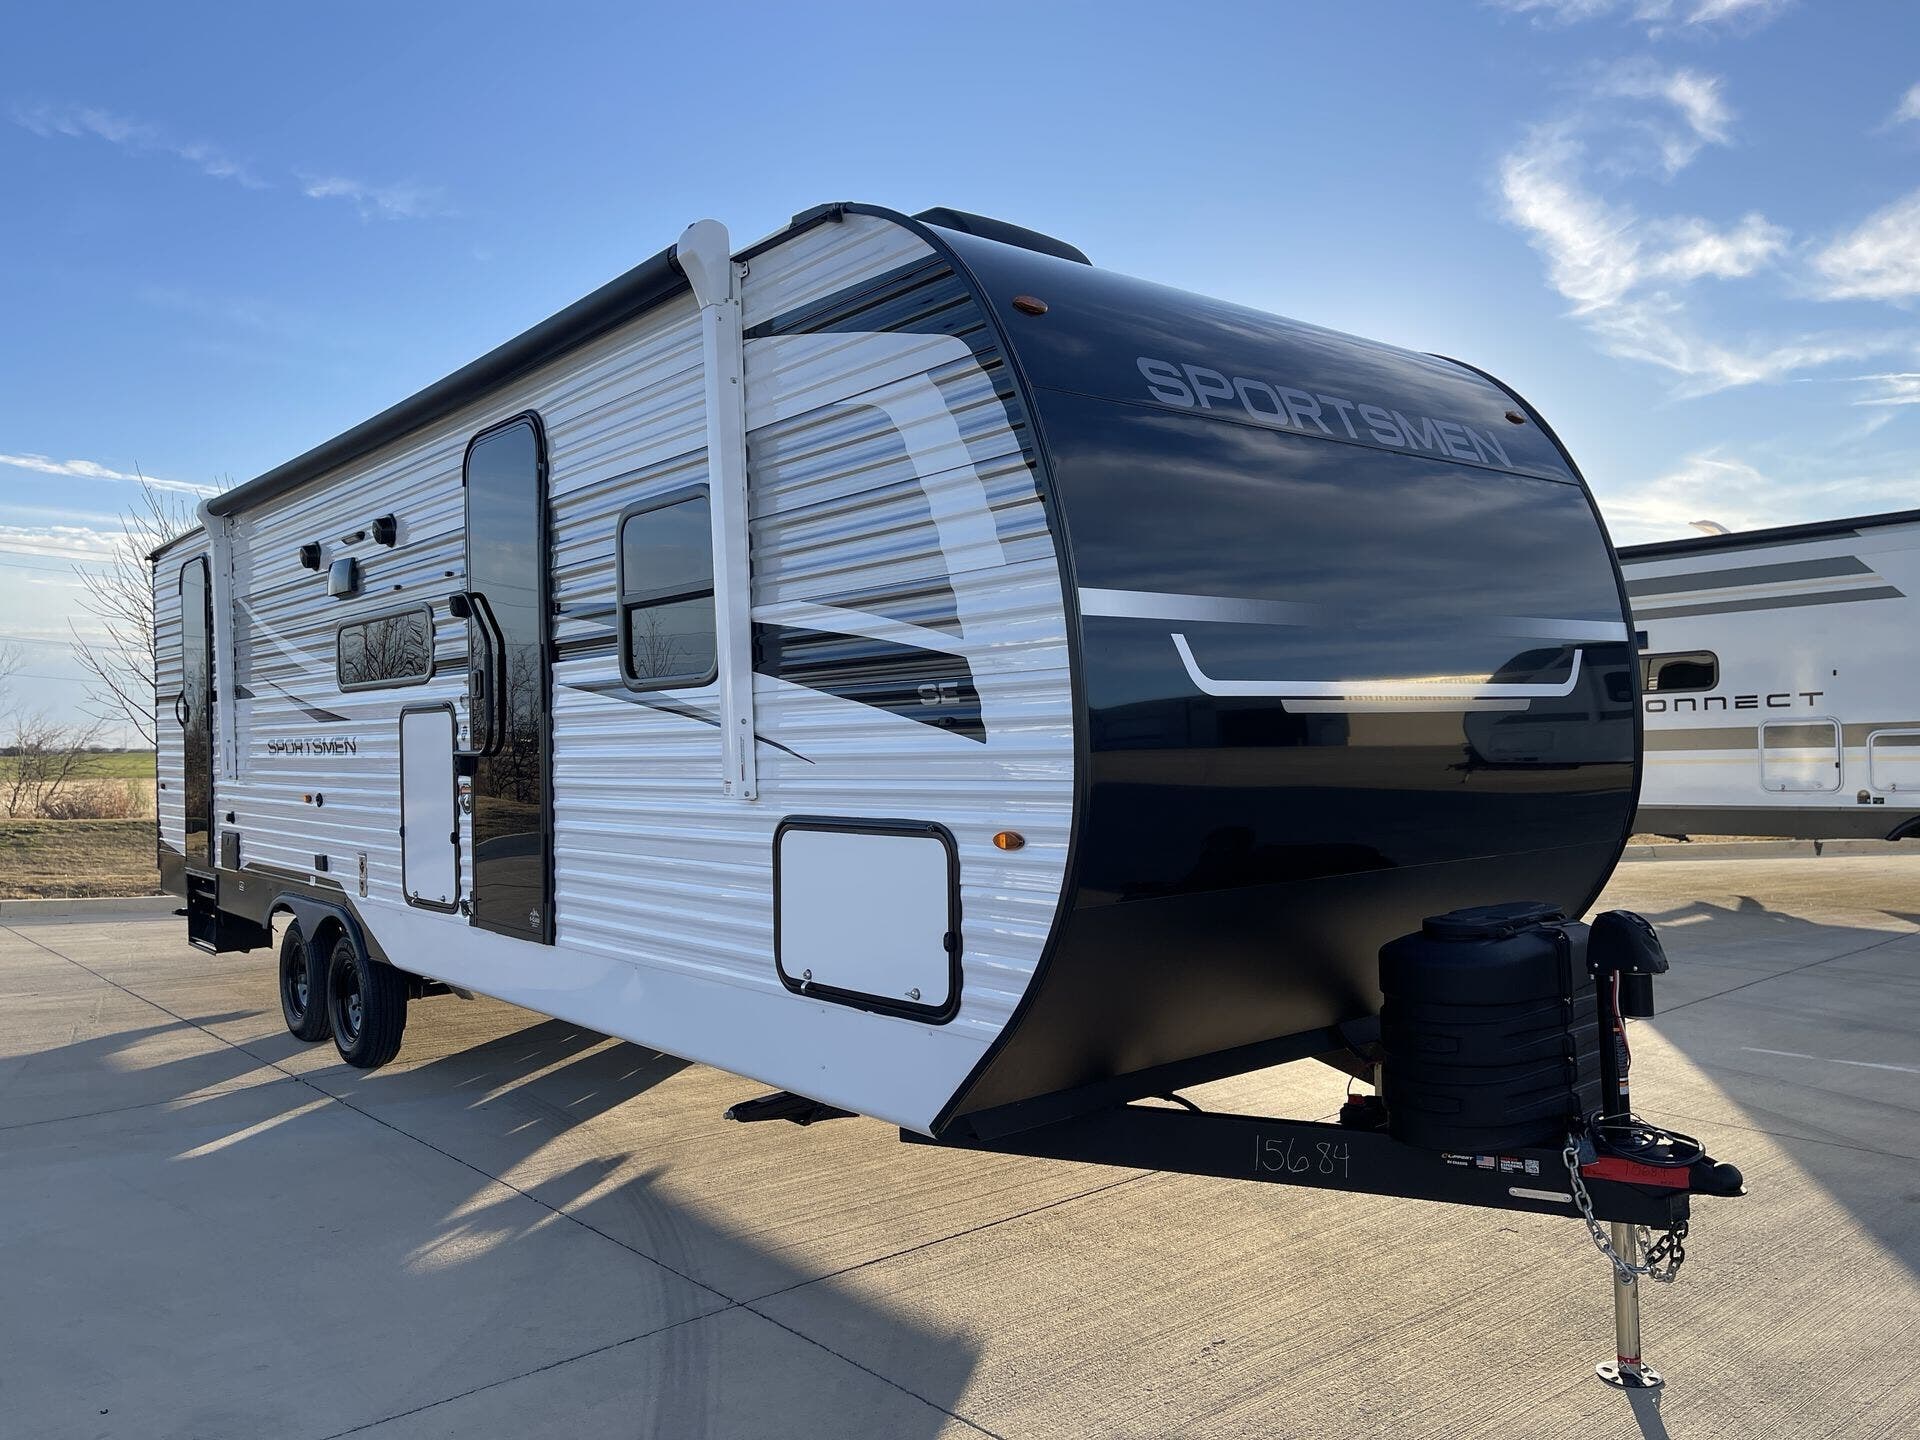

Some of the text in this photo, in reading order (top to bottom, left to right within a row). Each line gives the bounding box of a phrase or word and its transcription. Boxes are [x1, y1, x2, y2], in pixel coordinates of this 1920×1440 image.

[1136, 356, 1513, 468] SPORTSMEN
[917, 682, 960, 706] SE
[1645, 691, 1824, 713] ONNECT
[267, 736, 357, 756] SPORTSMEN
[1254, 1134, 1350, 1179] 15684
